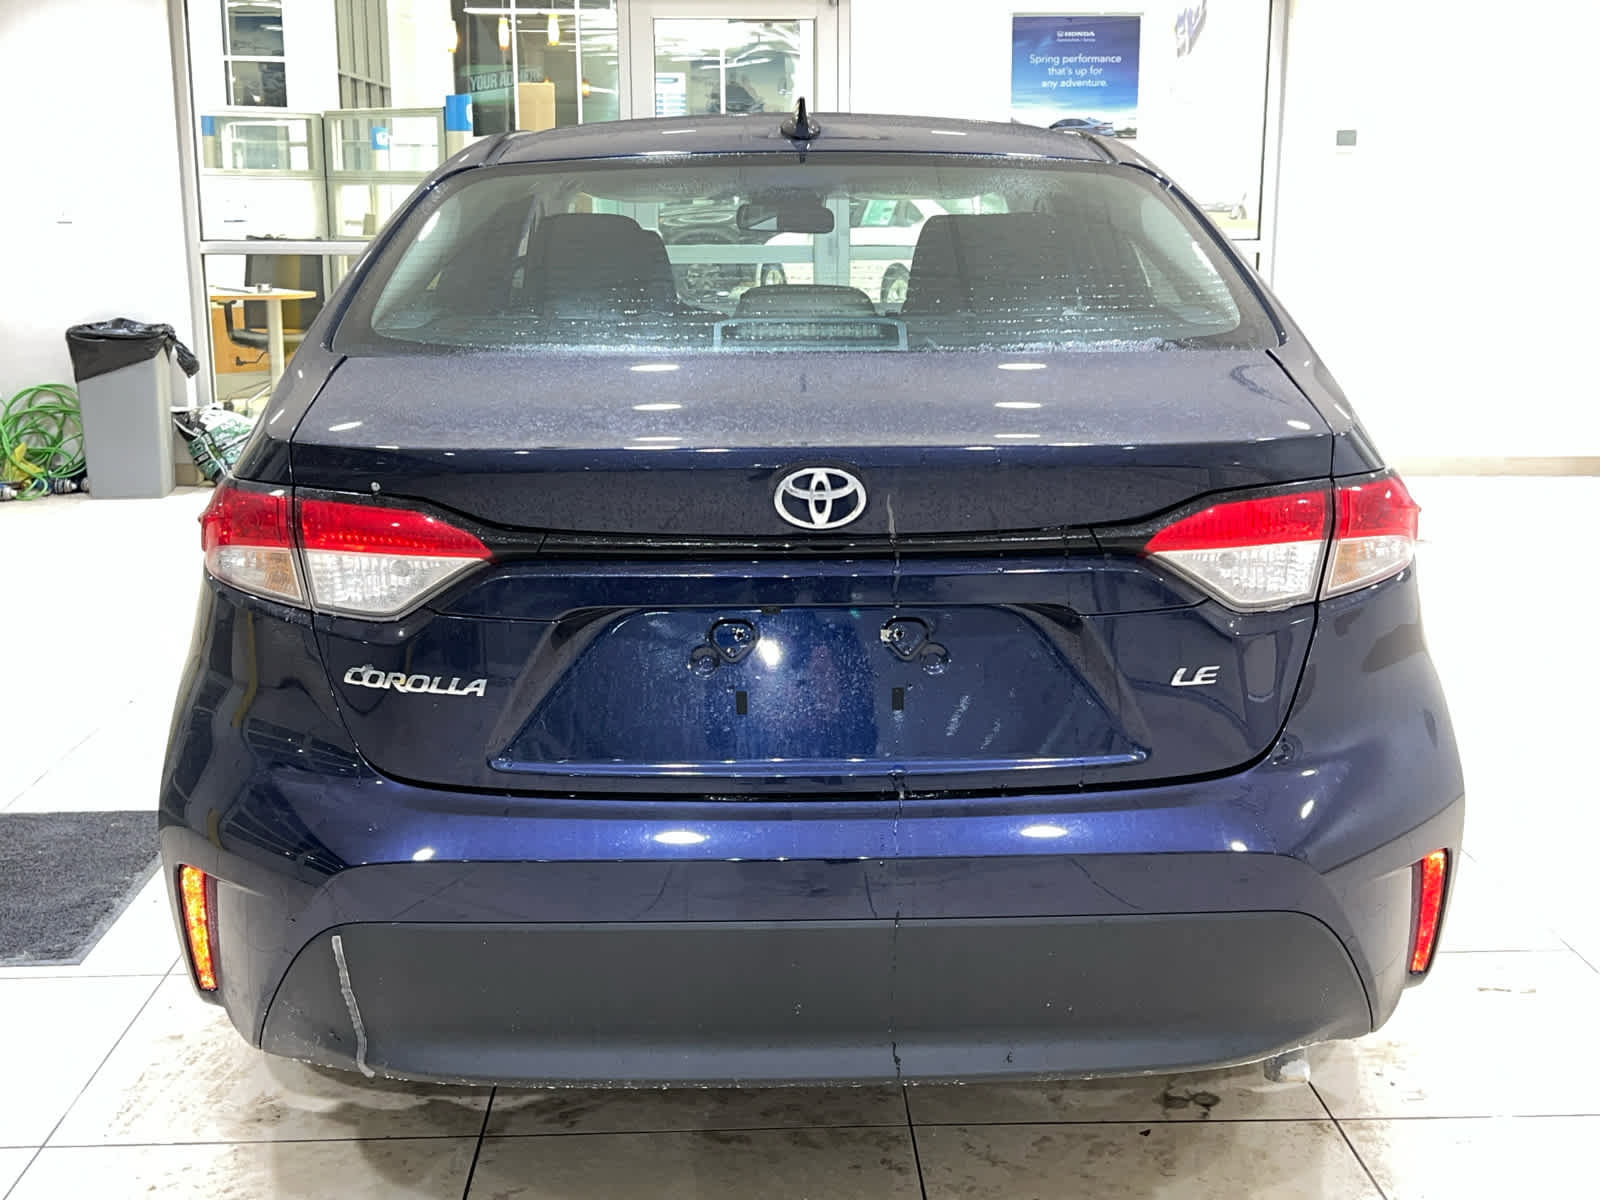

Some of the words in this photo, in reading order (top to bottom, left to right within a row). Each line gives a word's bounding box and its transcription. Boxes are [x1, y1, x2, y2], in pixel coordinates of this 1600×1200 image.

[1029, 54, 1060, 65] Spring
[1062, 53, 1122, 64] performance
[1048, 66, 1072, 75] that's
[1075, 69, 1087, 77] up
[1090, 65, 1103, 75] for
[1041, 80, 1058, 89] any
[1060, 78, 1107, 87] adventure.
[344, 664, 488, 697] COROLLA
[1171, 665, 1220, 686] LE
